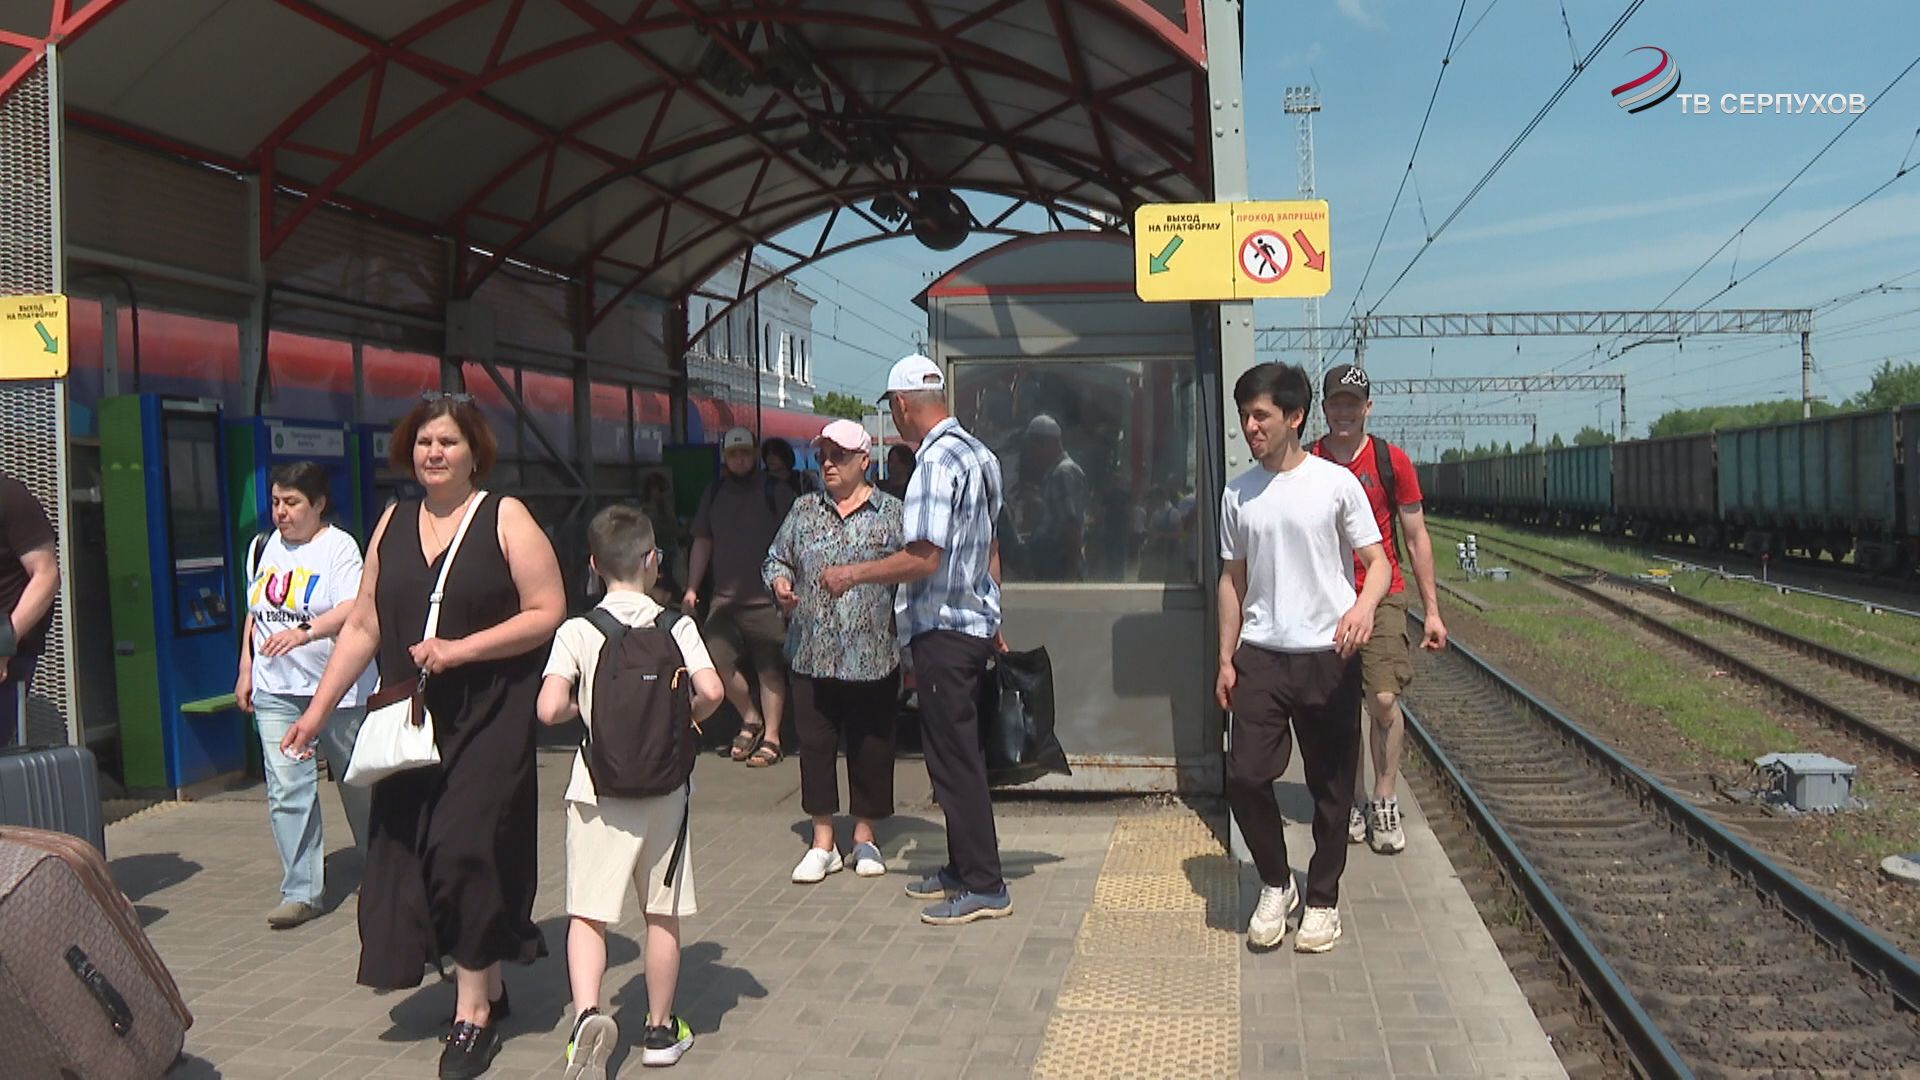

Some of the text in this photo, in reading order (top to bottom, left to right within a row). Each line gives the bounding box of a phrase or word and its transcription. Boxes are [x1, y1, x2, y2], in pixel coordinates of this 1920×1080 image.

[1166, 214, 1200, 223] ВЫХОД
[1236, 212, 1326, 223] ПРОХОД ЗАПРЕЩЕН
[1148, 223, 1221, 232] НА ПЛАТФОРМУ
